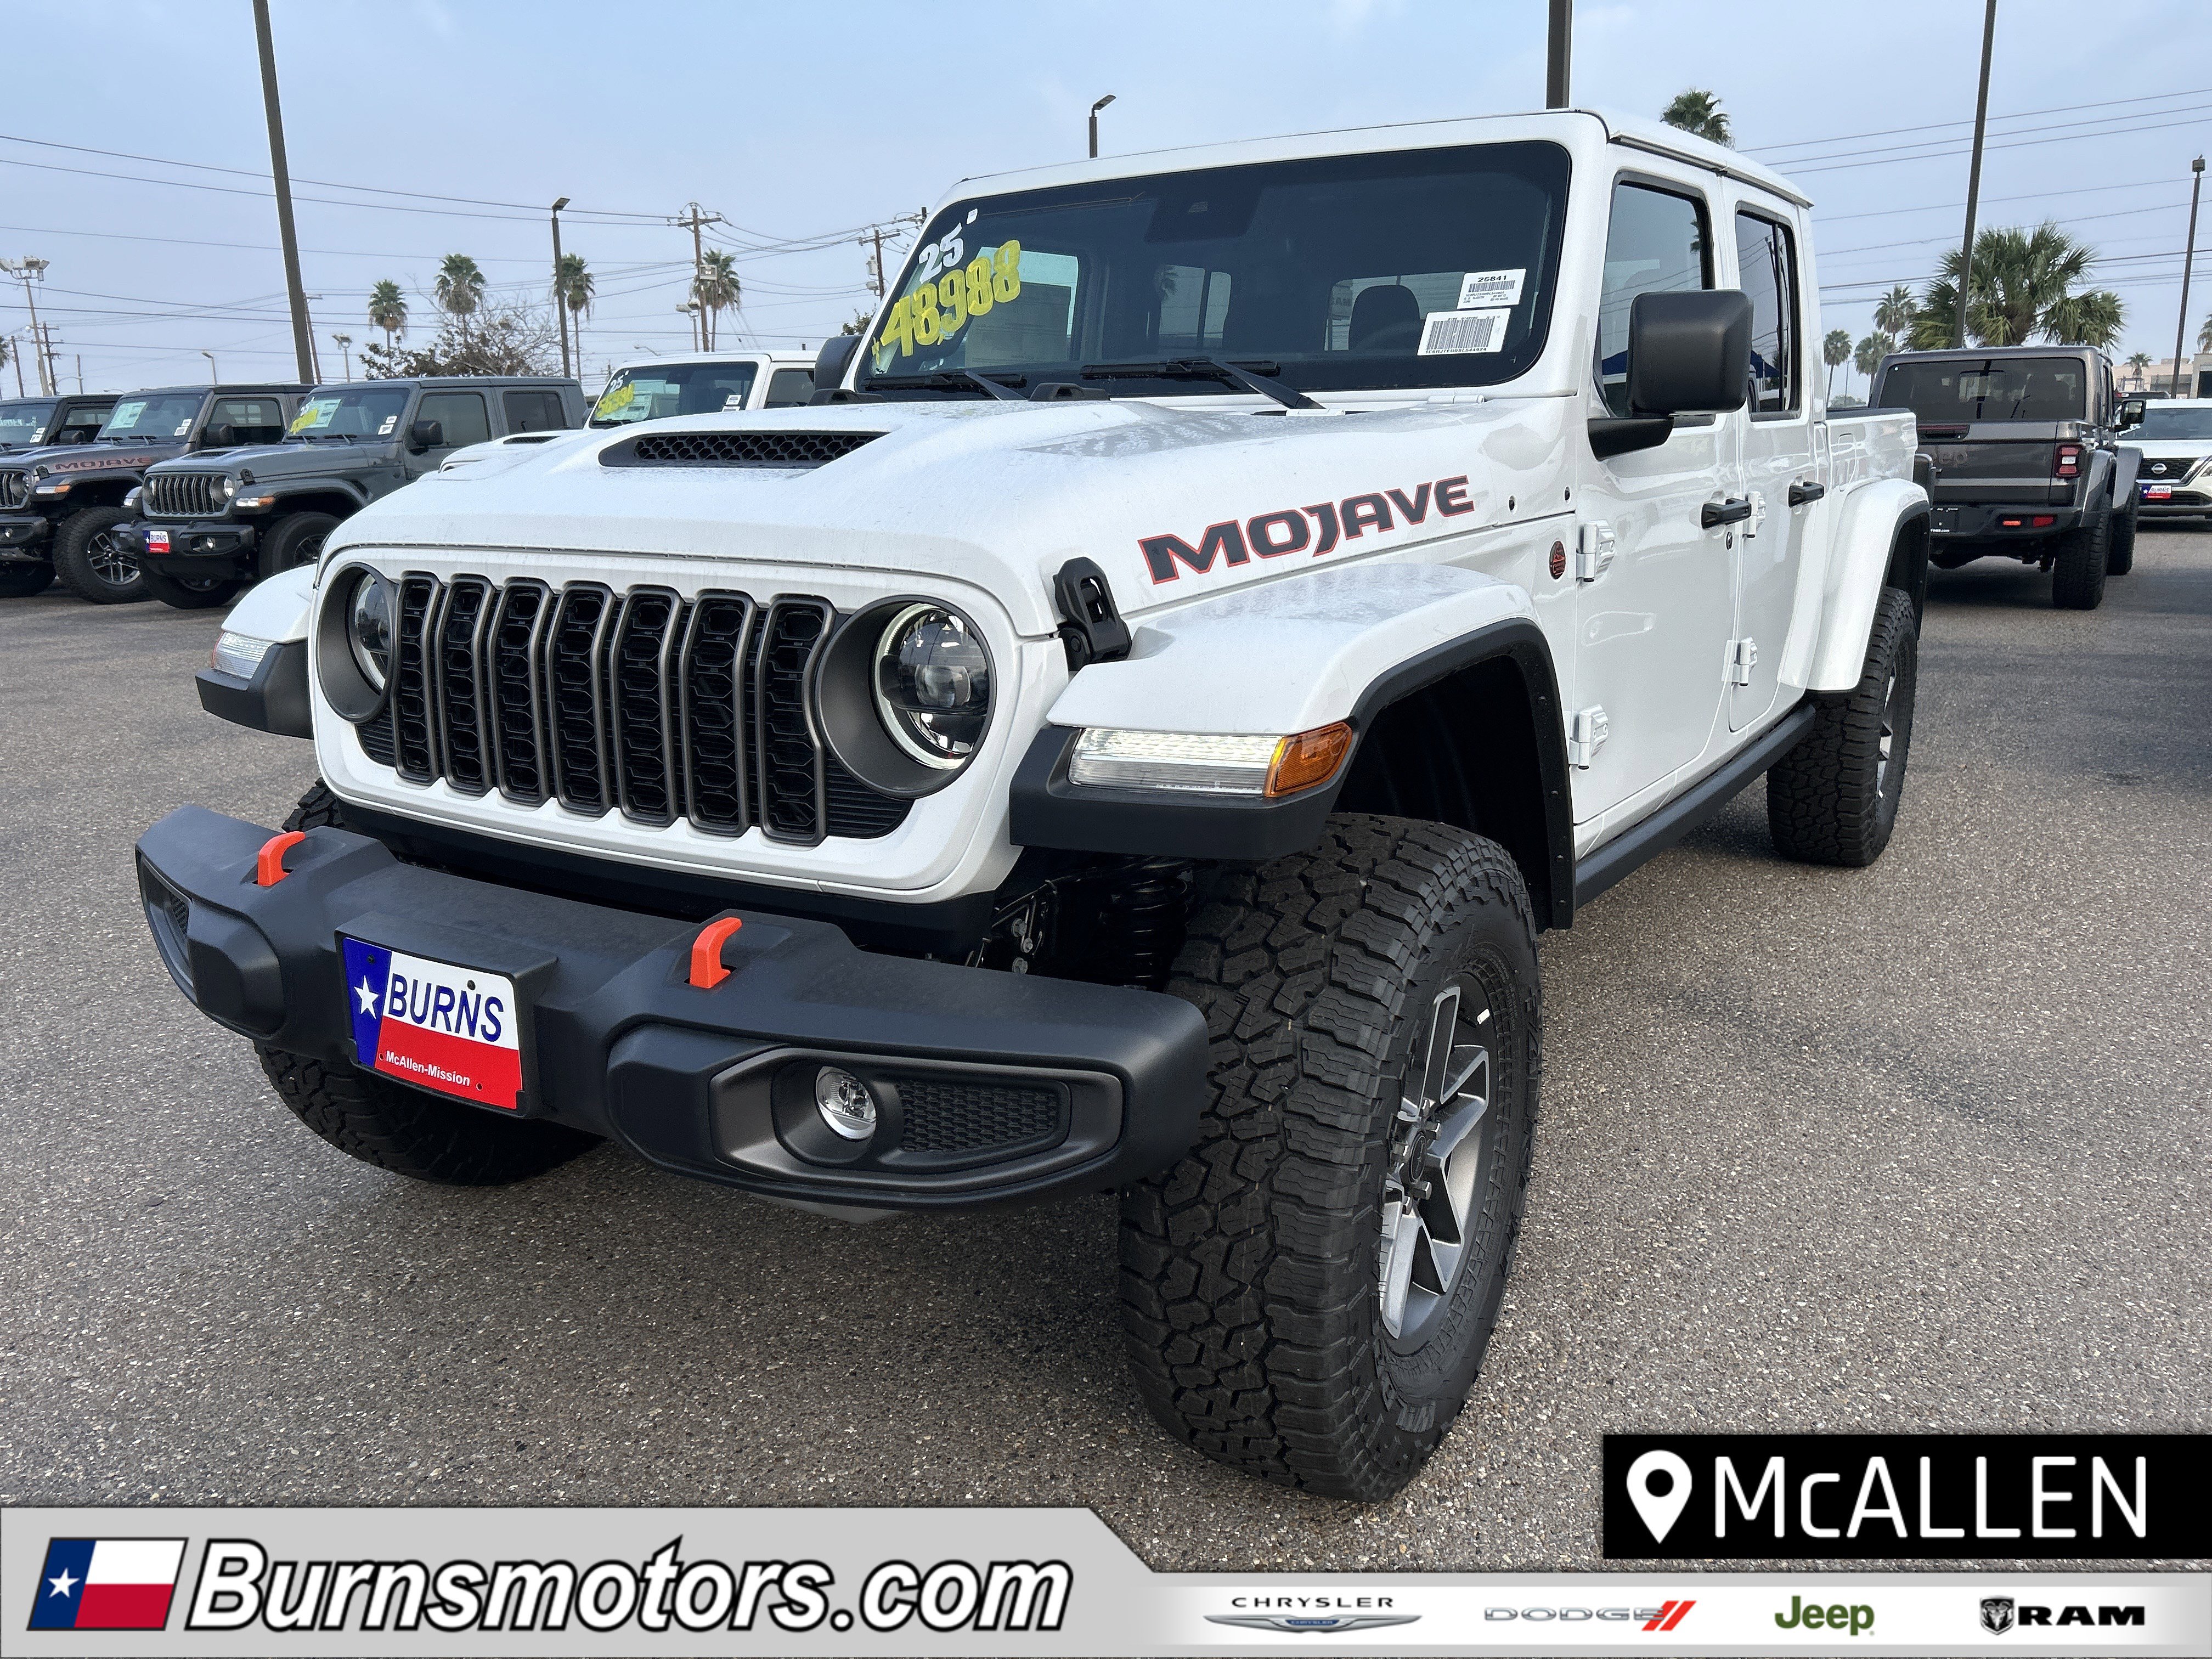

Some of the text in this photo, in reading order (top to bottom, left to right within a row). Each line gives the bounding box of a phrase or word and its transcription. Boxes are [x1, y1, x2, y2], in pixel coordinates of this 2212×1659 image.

[150, 534, 166, 543] BURNS
[1137, 475, 1475, 585] MOJAVE
[388, 973, 504, 1042] BURNS
[386, 1050, 471, 1087] McAllen-Mission
